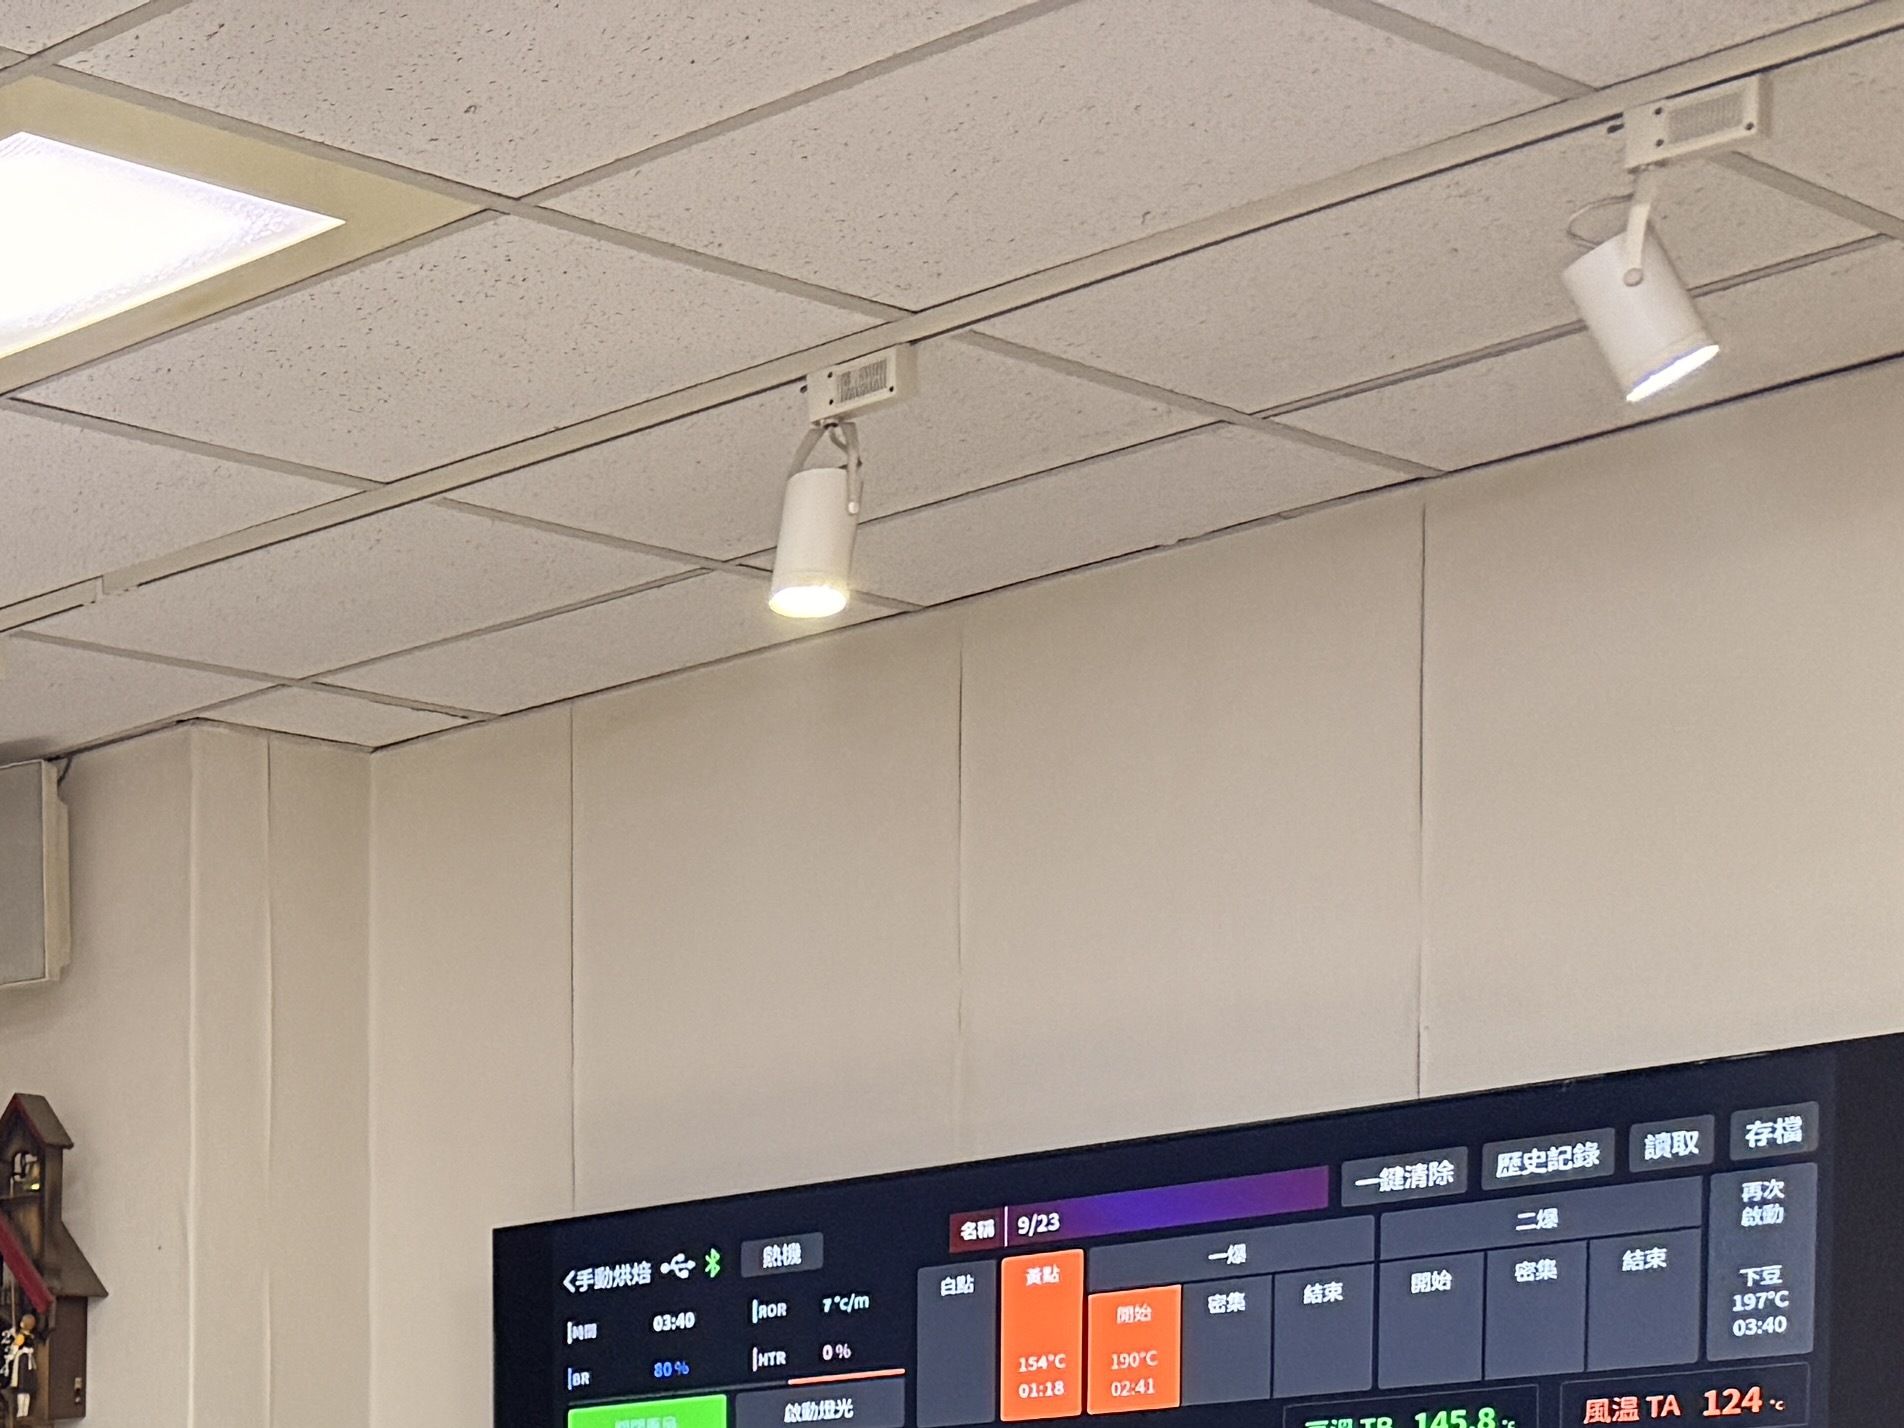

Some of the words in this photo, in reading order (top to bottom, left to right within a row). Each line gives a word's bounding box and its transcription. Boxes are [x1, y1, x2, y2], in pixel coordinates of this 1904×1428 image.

[1745, 1116, 1802, 1148] 存檔
[1644, 1130, 1699, 1160] 讀取
[1354, 1160, 1454, 1191] 一鍵清除
[1742, 1179, 1785, 1203] 再次
[960, 1219, 995, 1241] 名稱
[1017, 1212, 1061, 1236] 9/23
[1515, 1208, 1559, 1231] 二爆
[1208, 1243, 1247, 1265] 一爆
[1621, 1247, 1667, 1272] 結束
[575, 1262, 652, 1292] 手動烘焙
[1410, 1269, 1452, 1293] 開始
[1514, 1259, 1558, 1282] 密集
[1739, 1265, 1783, 1287] 下豆
[940, 1274, 975, 1296] 白點
[1303, 1281, 1343, 1305] 結束
[1207, 1291, 1246, 1314] 密集
[1732, 1290, 1789, 1312] 197°C
[652, 1312, 696, 1332] 03:40
[1117, 1303, 1152, 1324] 開始
[1732, 1315, 1787, 1337] 03:40
[758, 1350, 787, 1367] HTR
[1018, 1353, 1066, 1373] 154°C
[1111, 1350, 1158, 1371] 190°C
[1018, 1380, 1066, 1399] 01:18
[1110, 1378, 1156, 1398] 02:41
[1646, 1395, 1682, 1420] TA
[1701, 1385, 1763, 1417] 124
